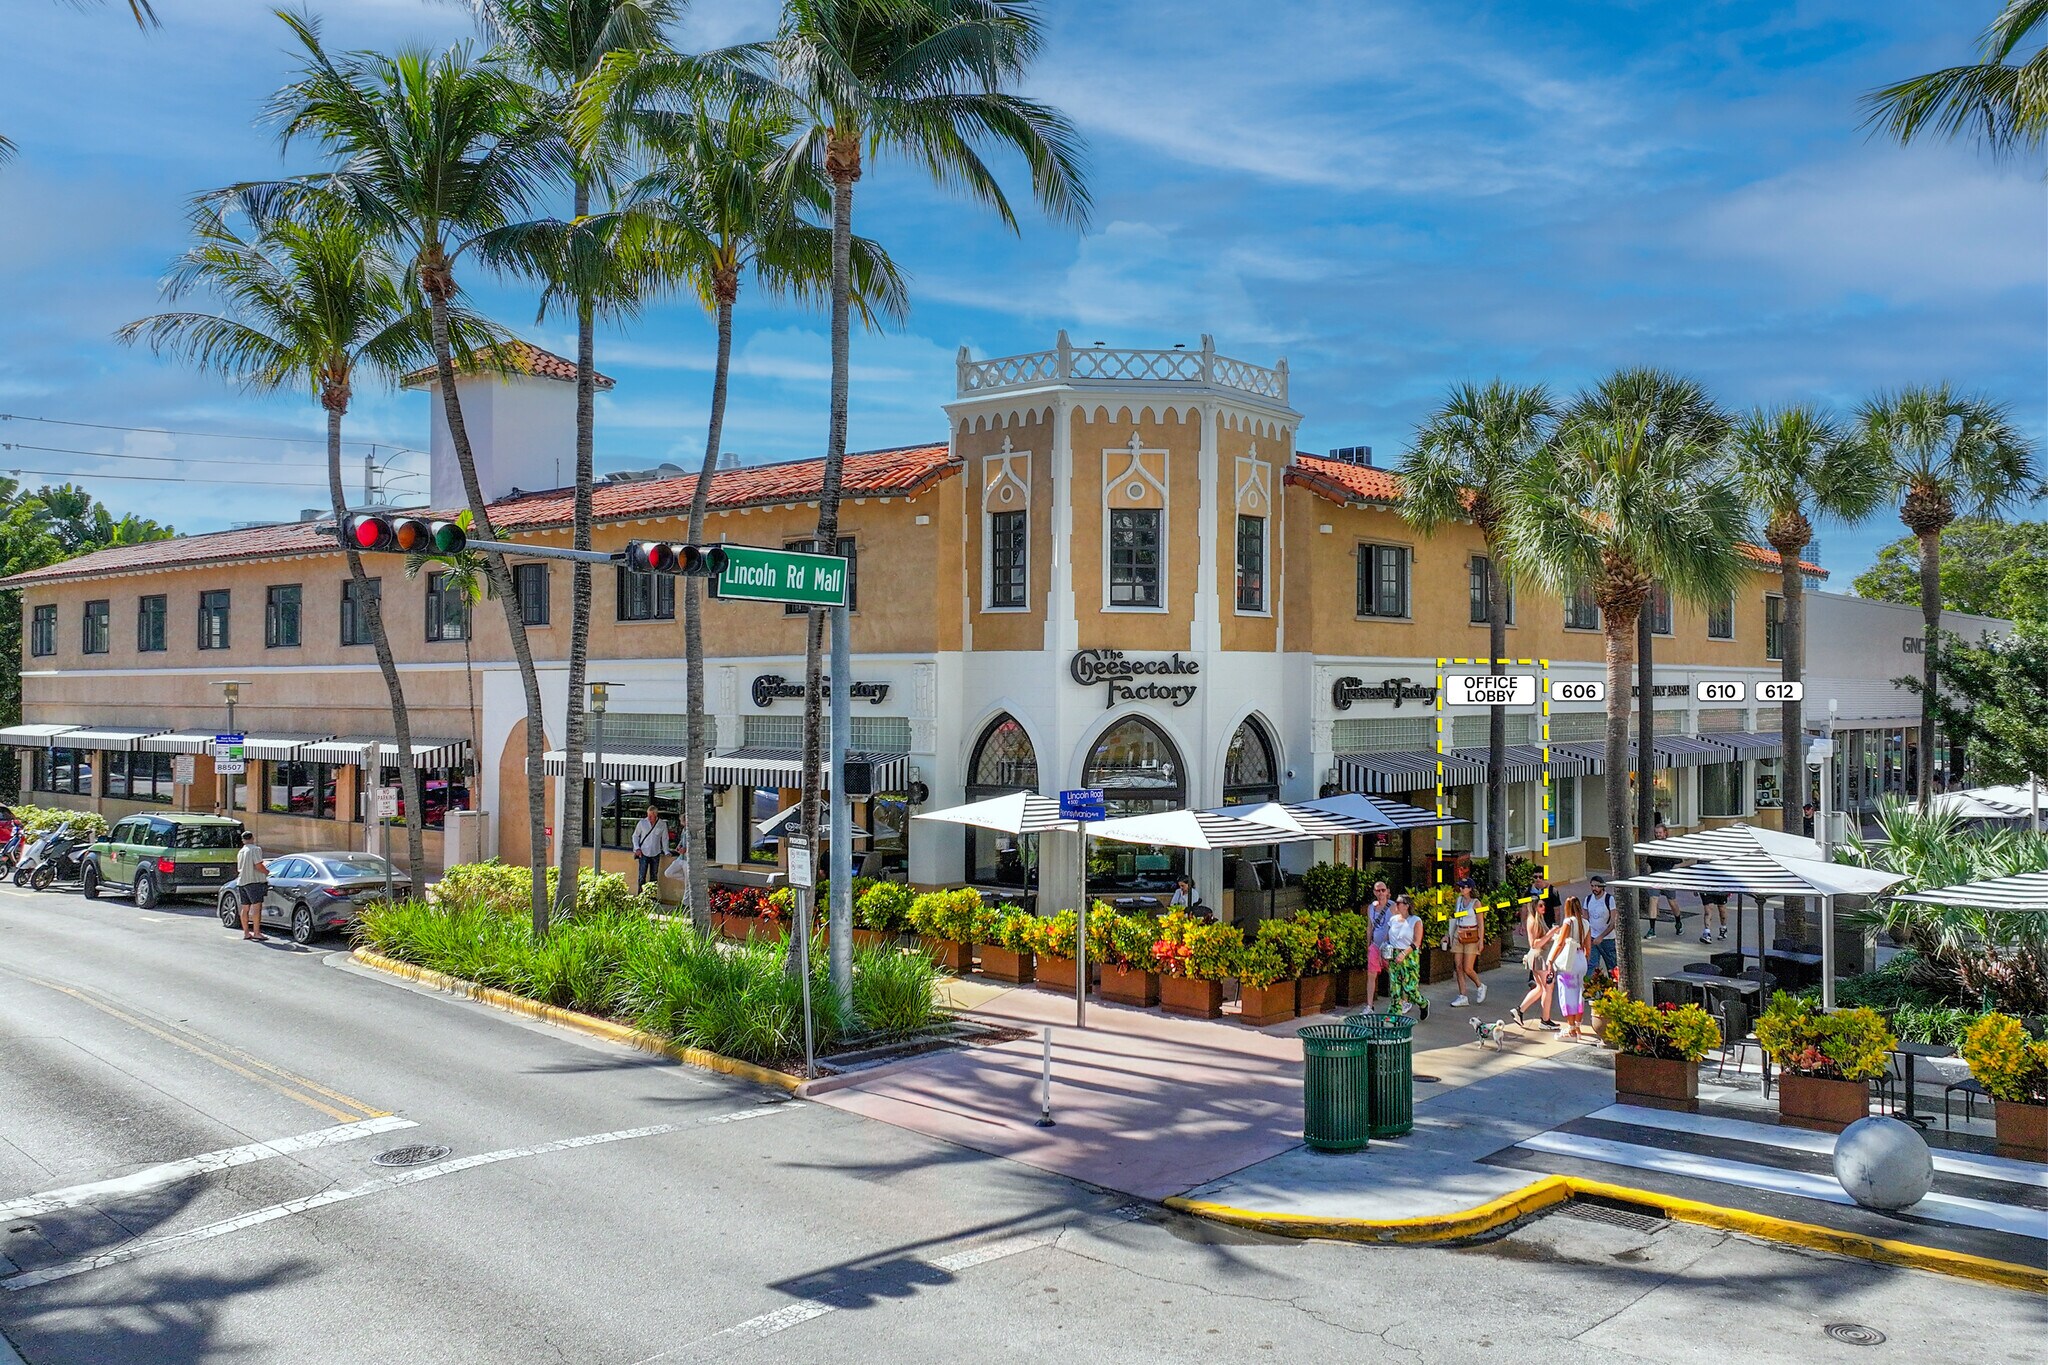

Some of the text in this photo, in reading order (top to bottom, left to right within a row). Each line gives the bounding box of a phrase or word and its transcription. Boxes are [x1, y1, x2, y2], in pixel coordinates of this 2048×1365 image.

[726, 559, 841, 592] Lincoln Rd Mall
[1070, 649, 1200, 686] Cheesecake
[1101, 649, 1124, 660] The
[1096, 675, 1197, 709] Factory
[1066, 791, 1089, 800] Lincoln
[1089, 790, 1104, 798] Road
